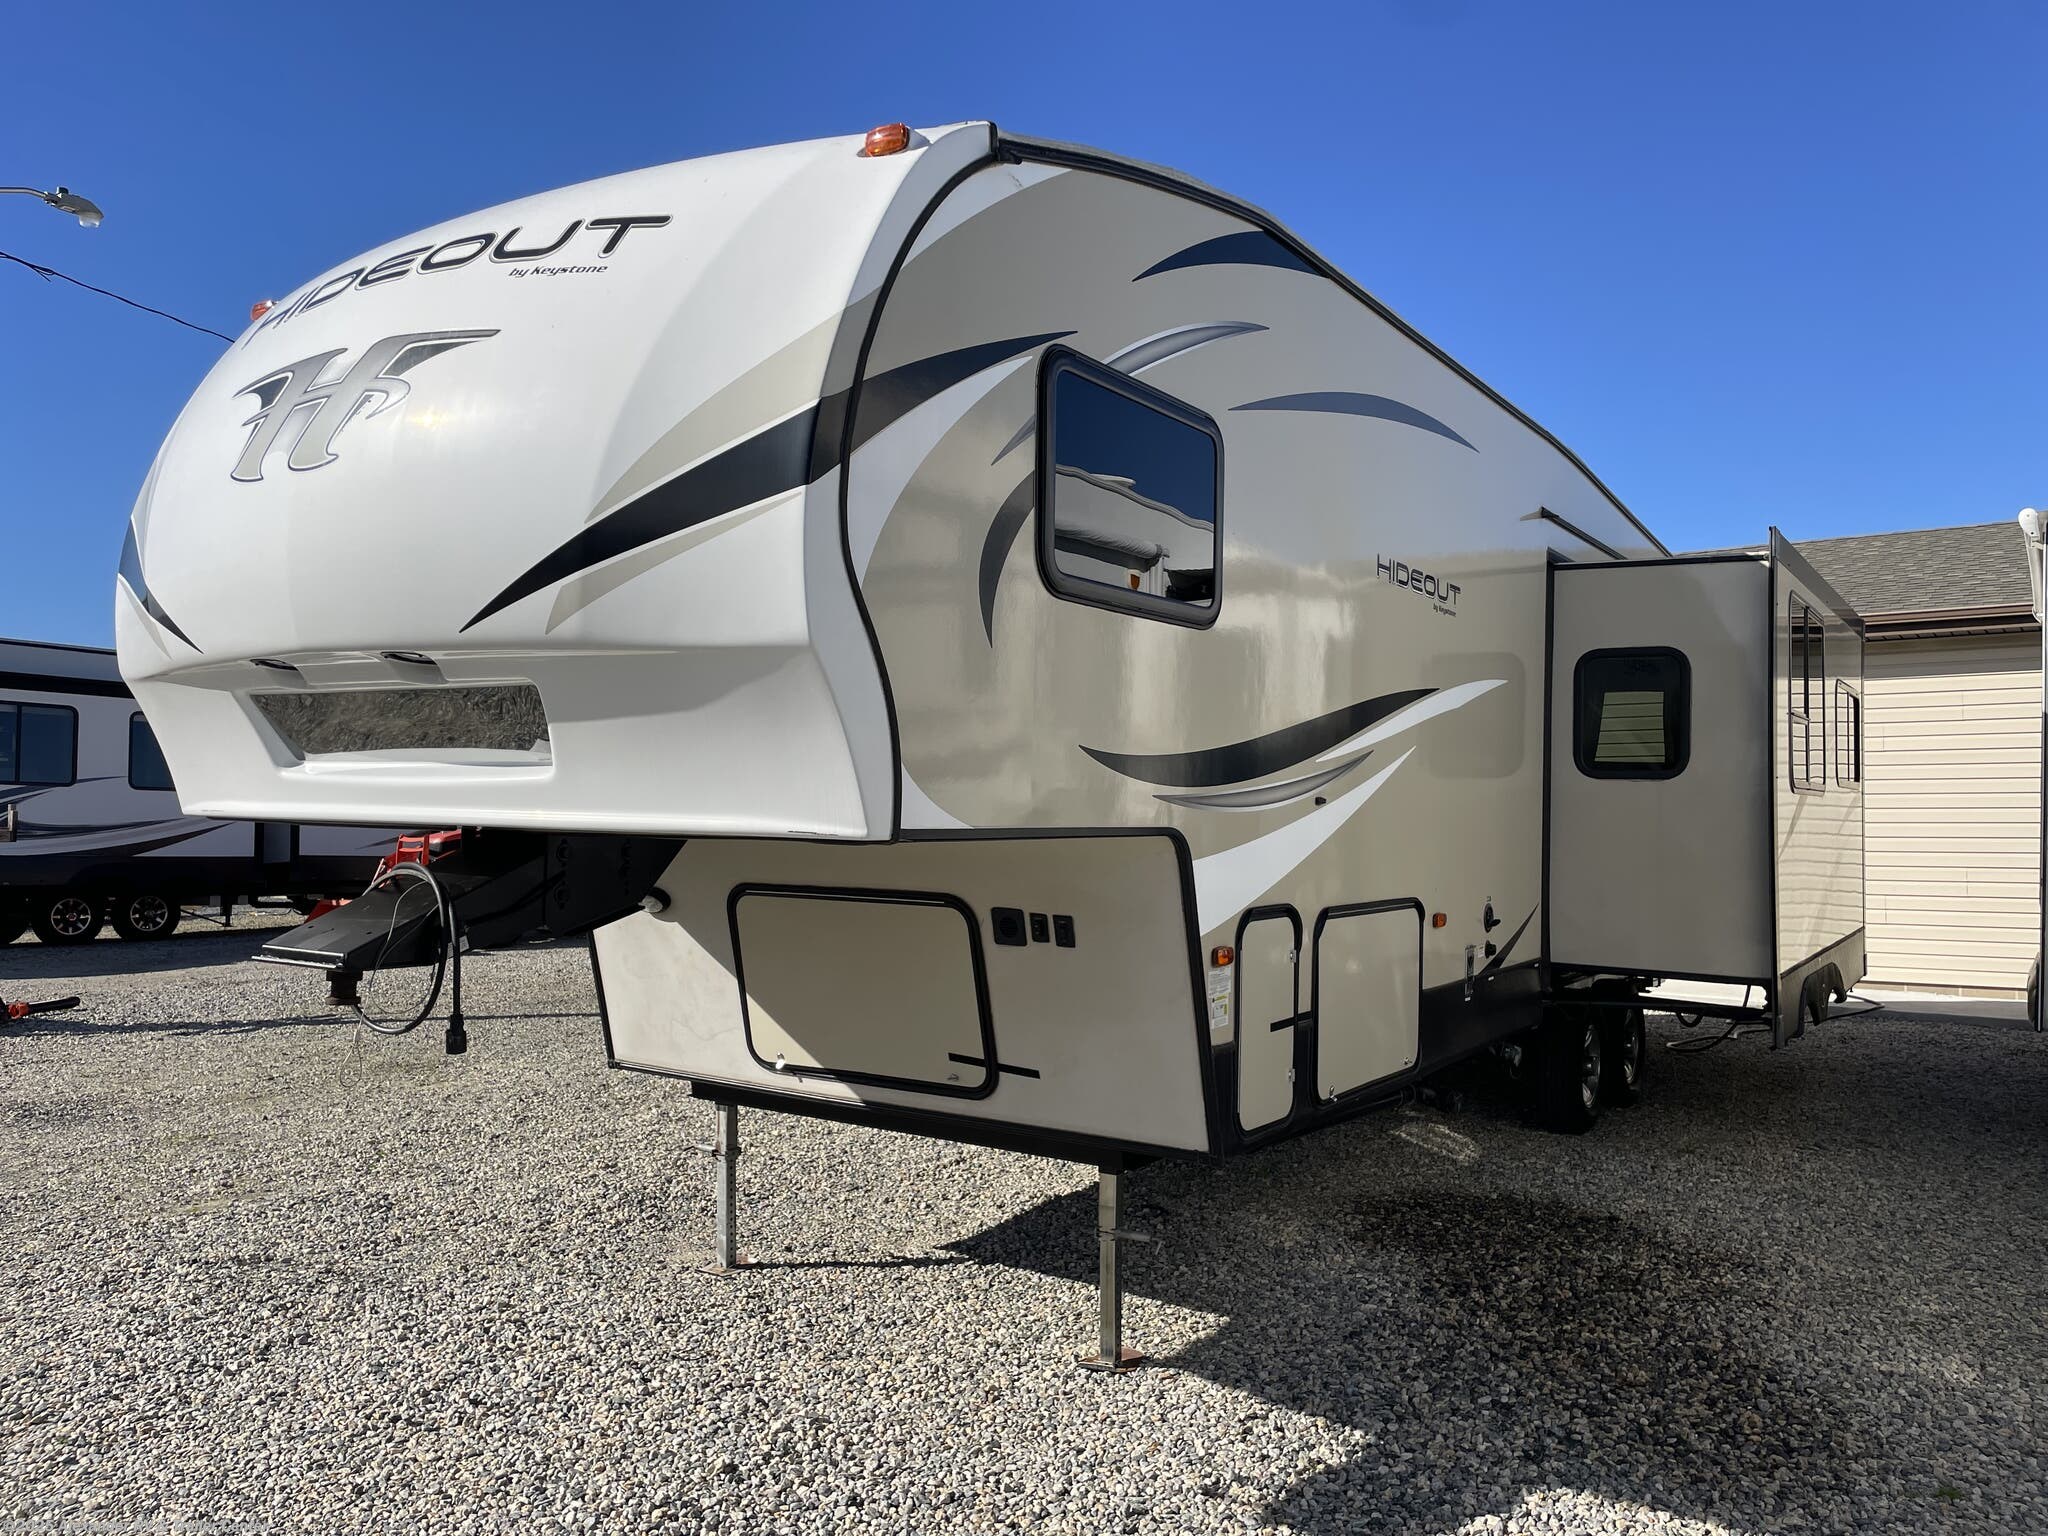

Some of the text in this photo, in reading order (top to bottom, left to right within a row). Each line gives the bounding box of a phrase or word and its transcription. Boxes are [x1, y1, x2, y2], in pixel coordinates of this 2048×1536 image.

[241, 214, 674, 350] HIDEOUT
[508, 265, 608, 278] by Keystone
[1376, 553, 1461, 606] HIDEOUT
